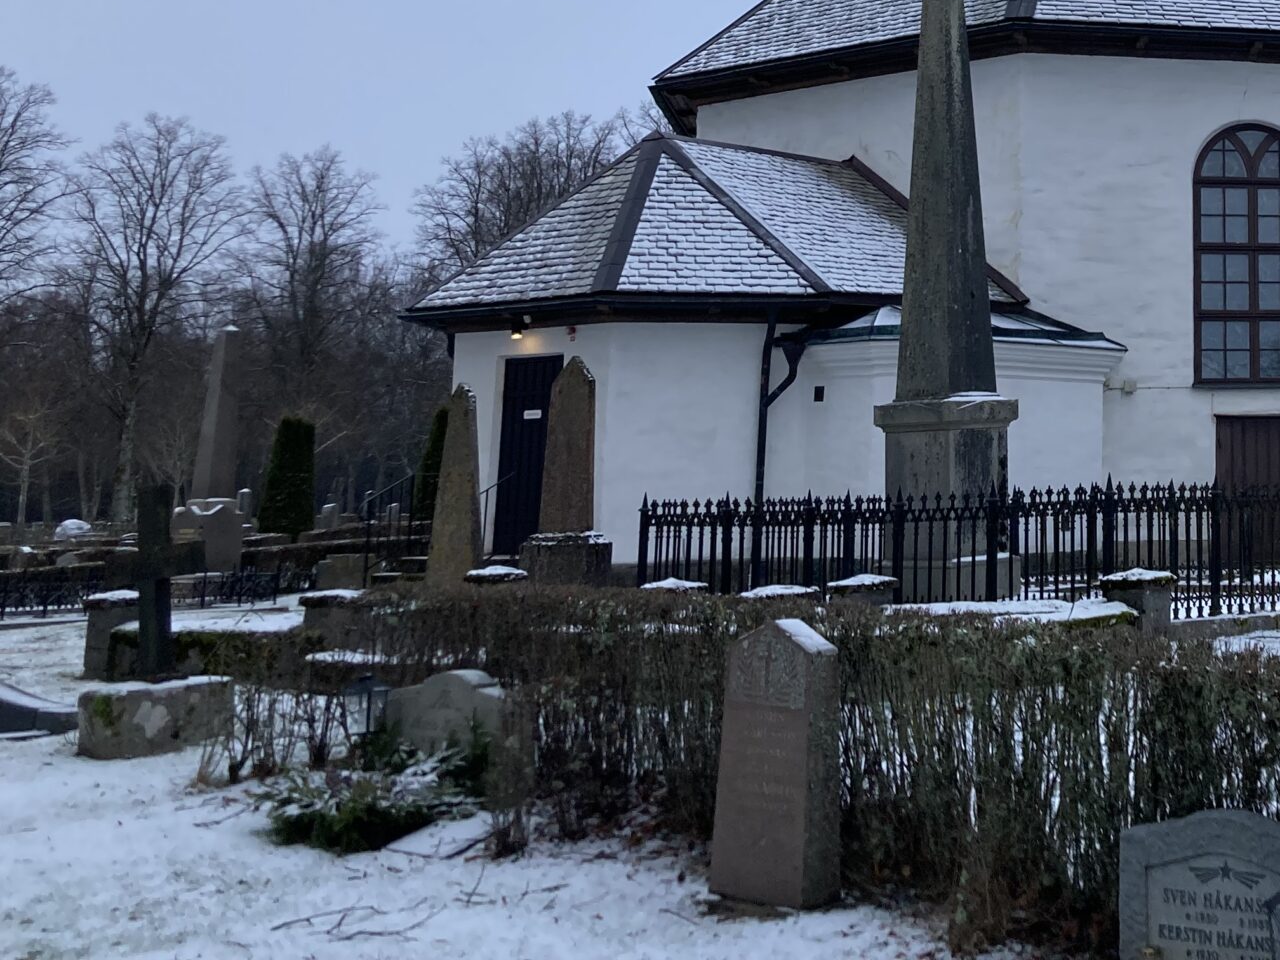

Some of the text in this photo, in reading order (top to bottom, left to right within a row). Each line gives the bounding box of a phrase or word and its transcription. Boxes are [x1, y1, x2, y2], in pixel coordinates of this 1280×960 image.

[1163, 888, 1268, 915] SVEN HÅKANS
[1158, 923, 1213, 945] KERSTIN
